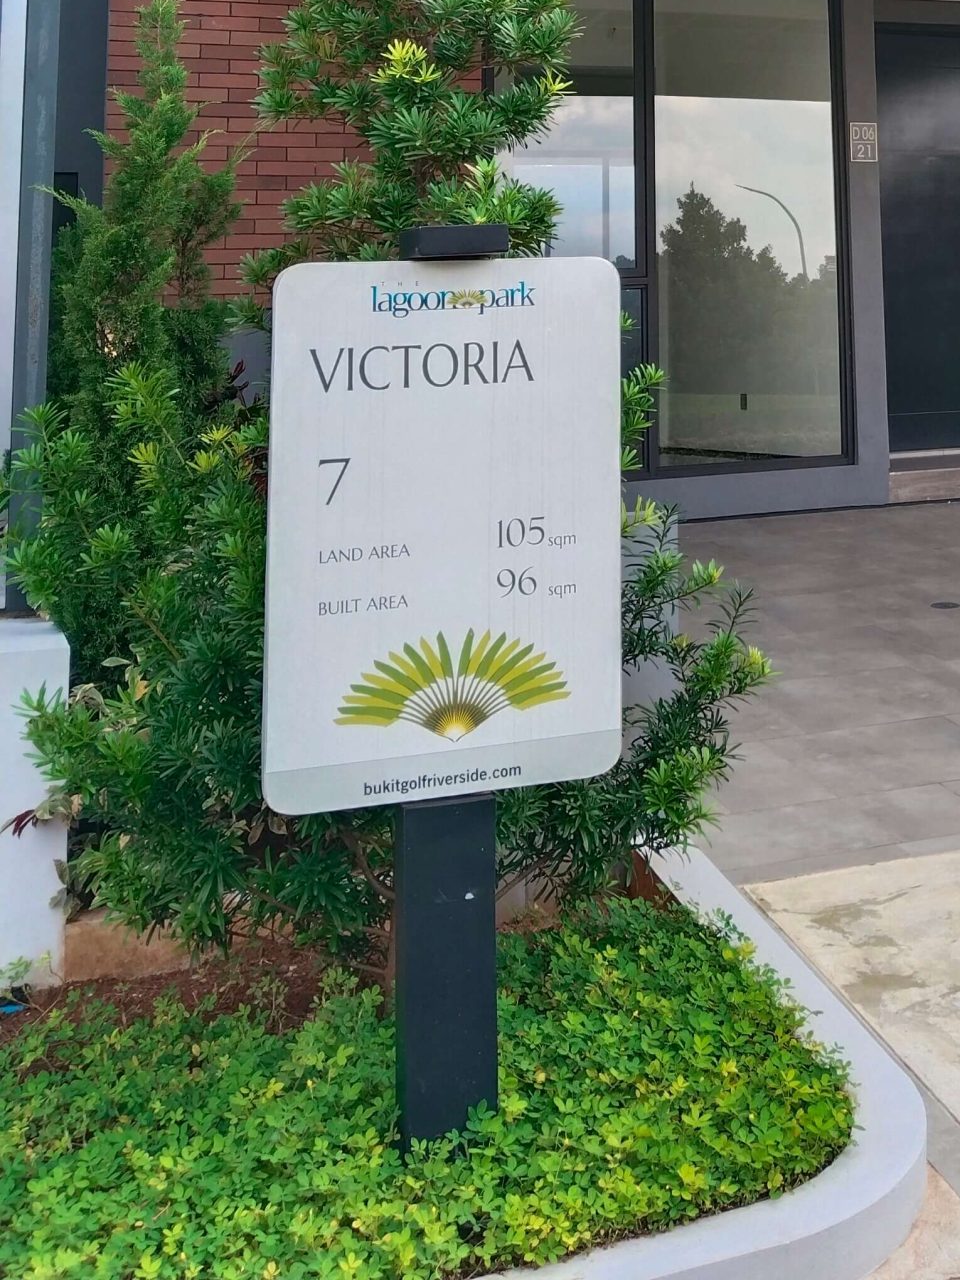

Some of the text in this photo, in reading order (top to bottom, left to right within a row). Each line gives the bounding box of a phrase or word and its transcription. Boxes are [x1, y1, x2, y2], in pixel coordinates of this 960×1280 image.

[857, 144, 871, 158] 21
[370, 280, 537, 318] lagoon park
[309, 339, 534, 393] VICTORIA
[318, 457, 351, 507] 7
[318, 516, 577, 565] LAND AREA 105 sqm
[317, 566, 577, 617] BUILT AREA 96 sqm
[363, 764, 522, 797] bukitgolfriverside.com
